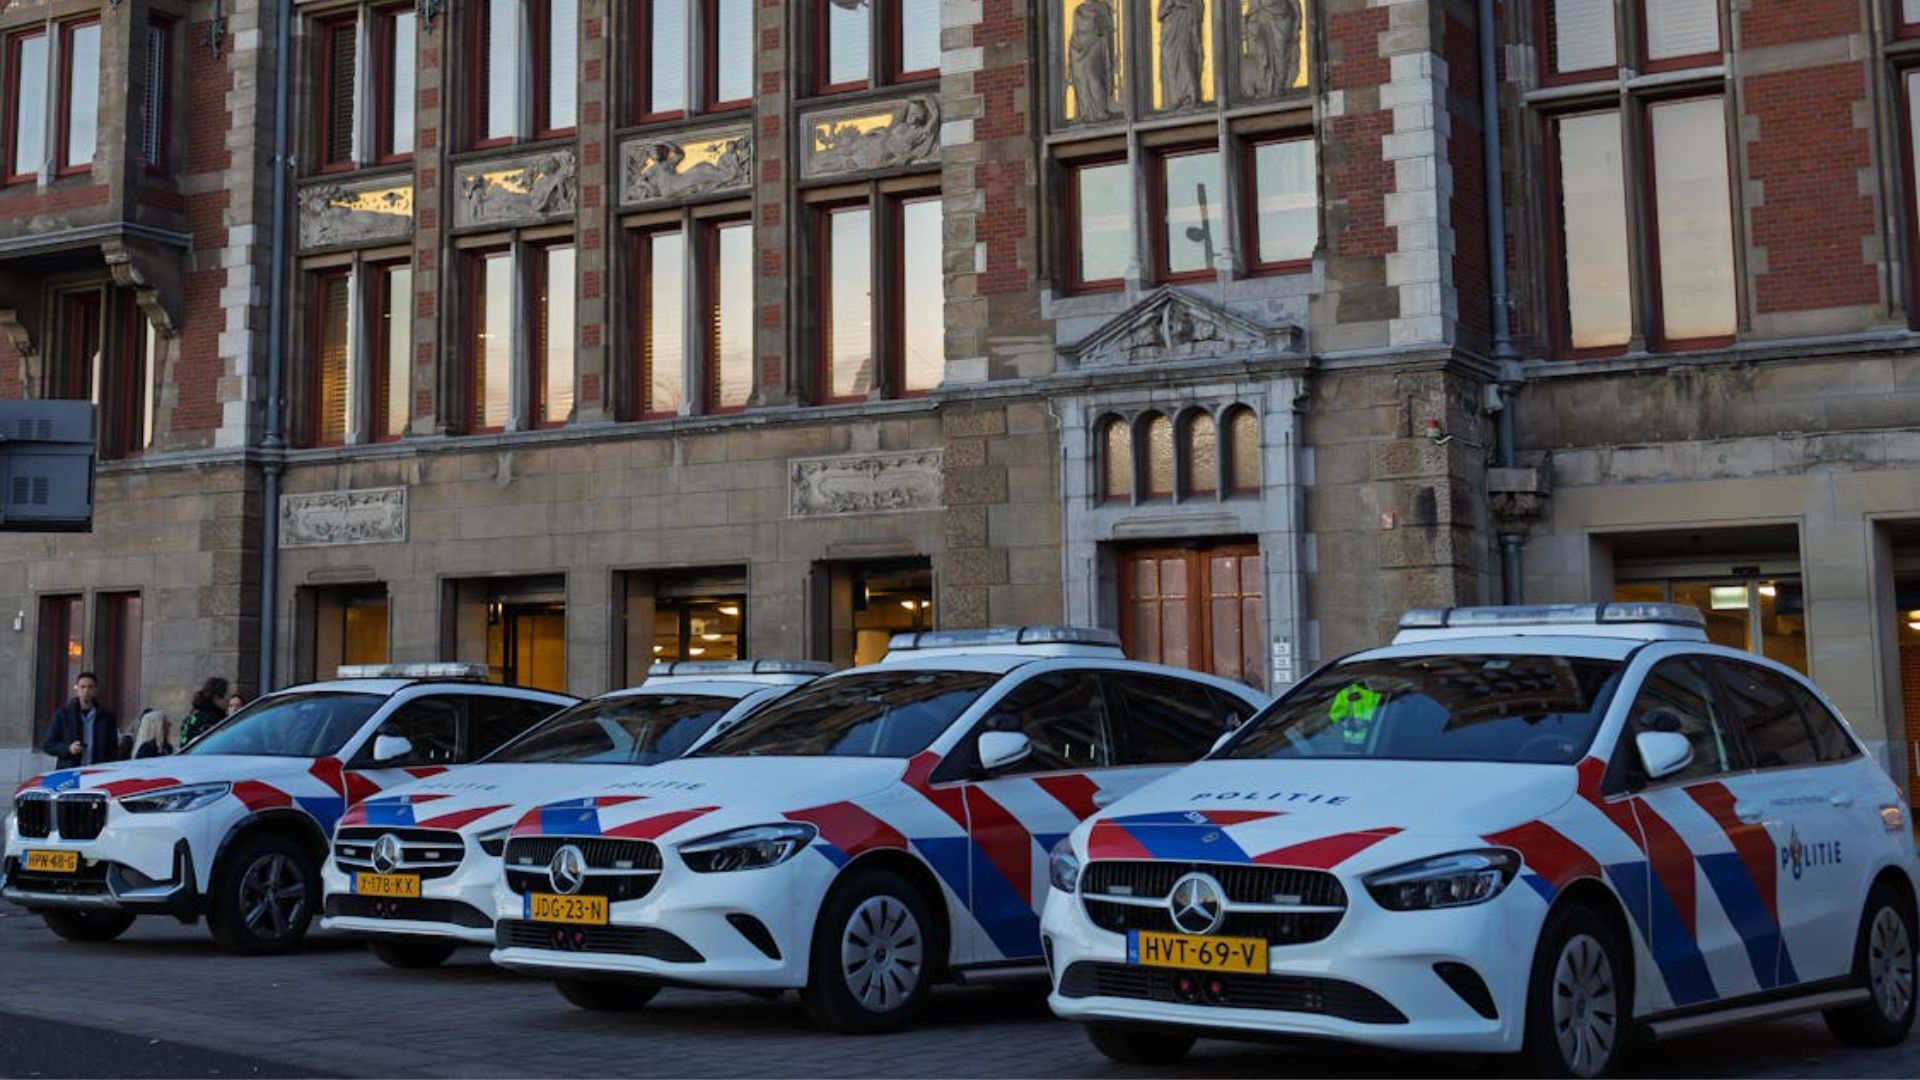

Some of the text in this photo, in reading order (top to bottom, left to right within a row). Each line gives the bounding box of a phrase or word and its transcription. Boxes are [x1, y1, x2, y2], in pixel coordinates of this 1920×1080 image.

[1189, 792, 1351, 806] POLITIE
[1781, 841, 1842, 880] POLITIE
[534, 897, 602, 919] JDG-23-N
[1145, 936, 1256, 967] HVT-69-V
